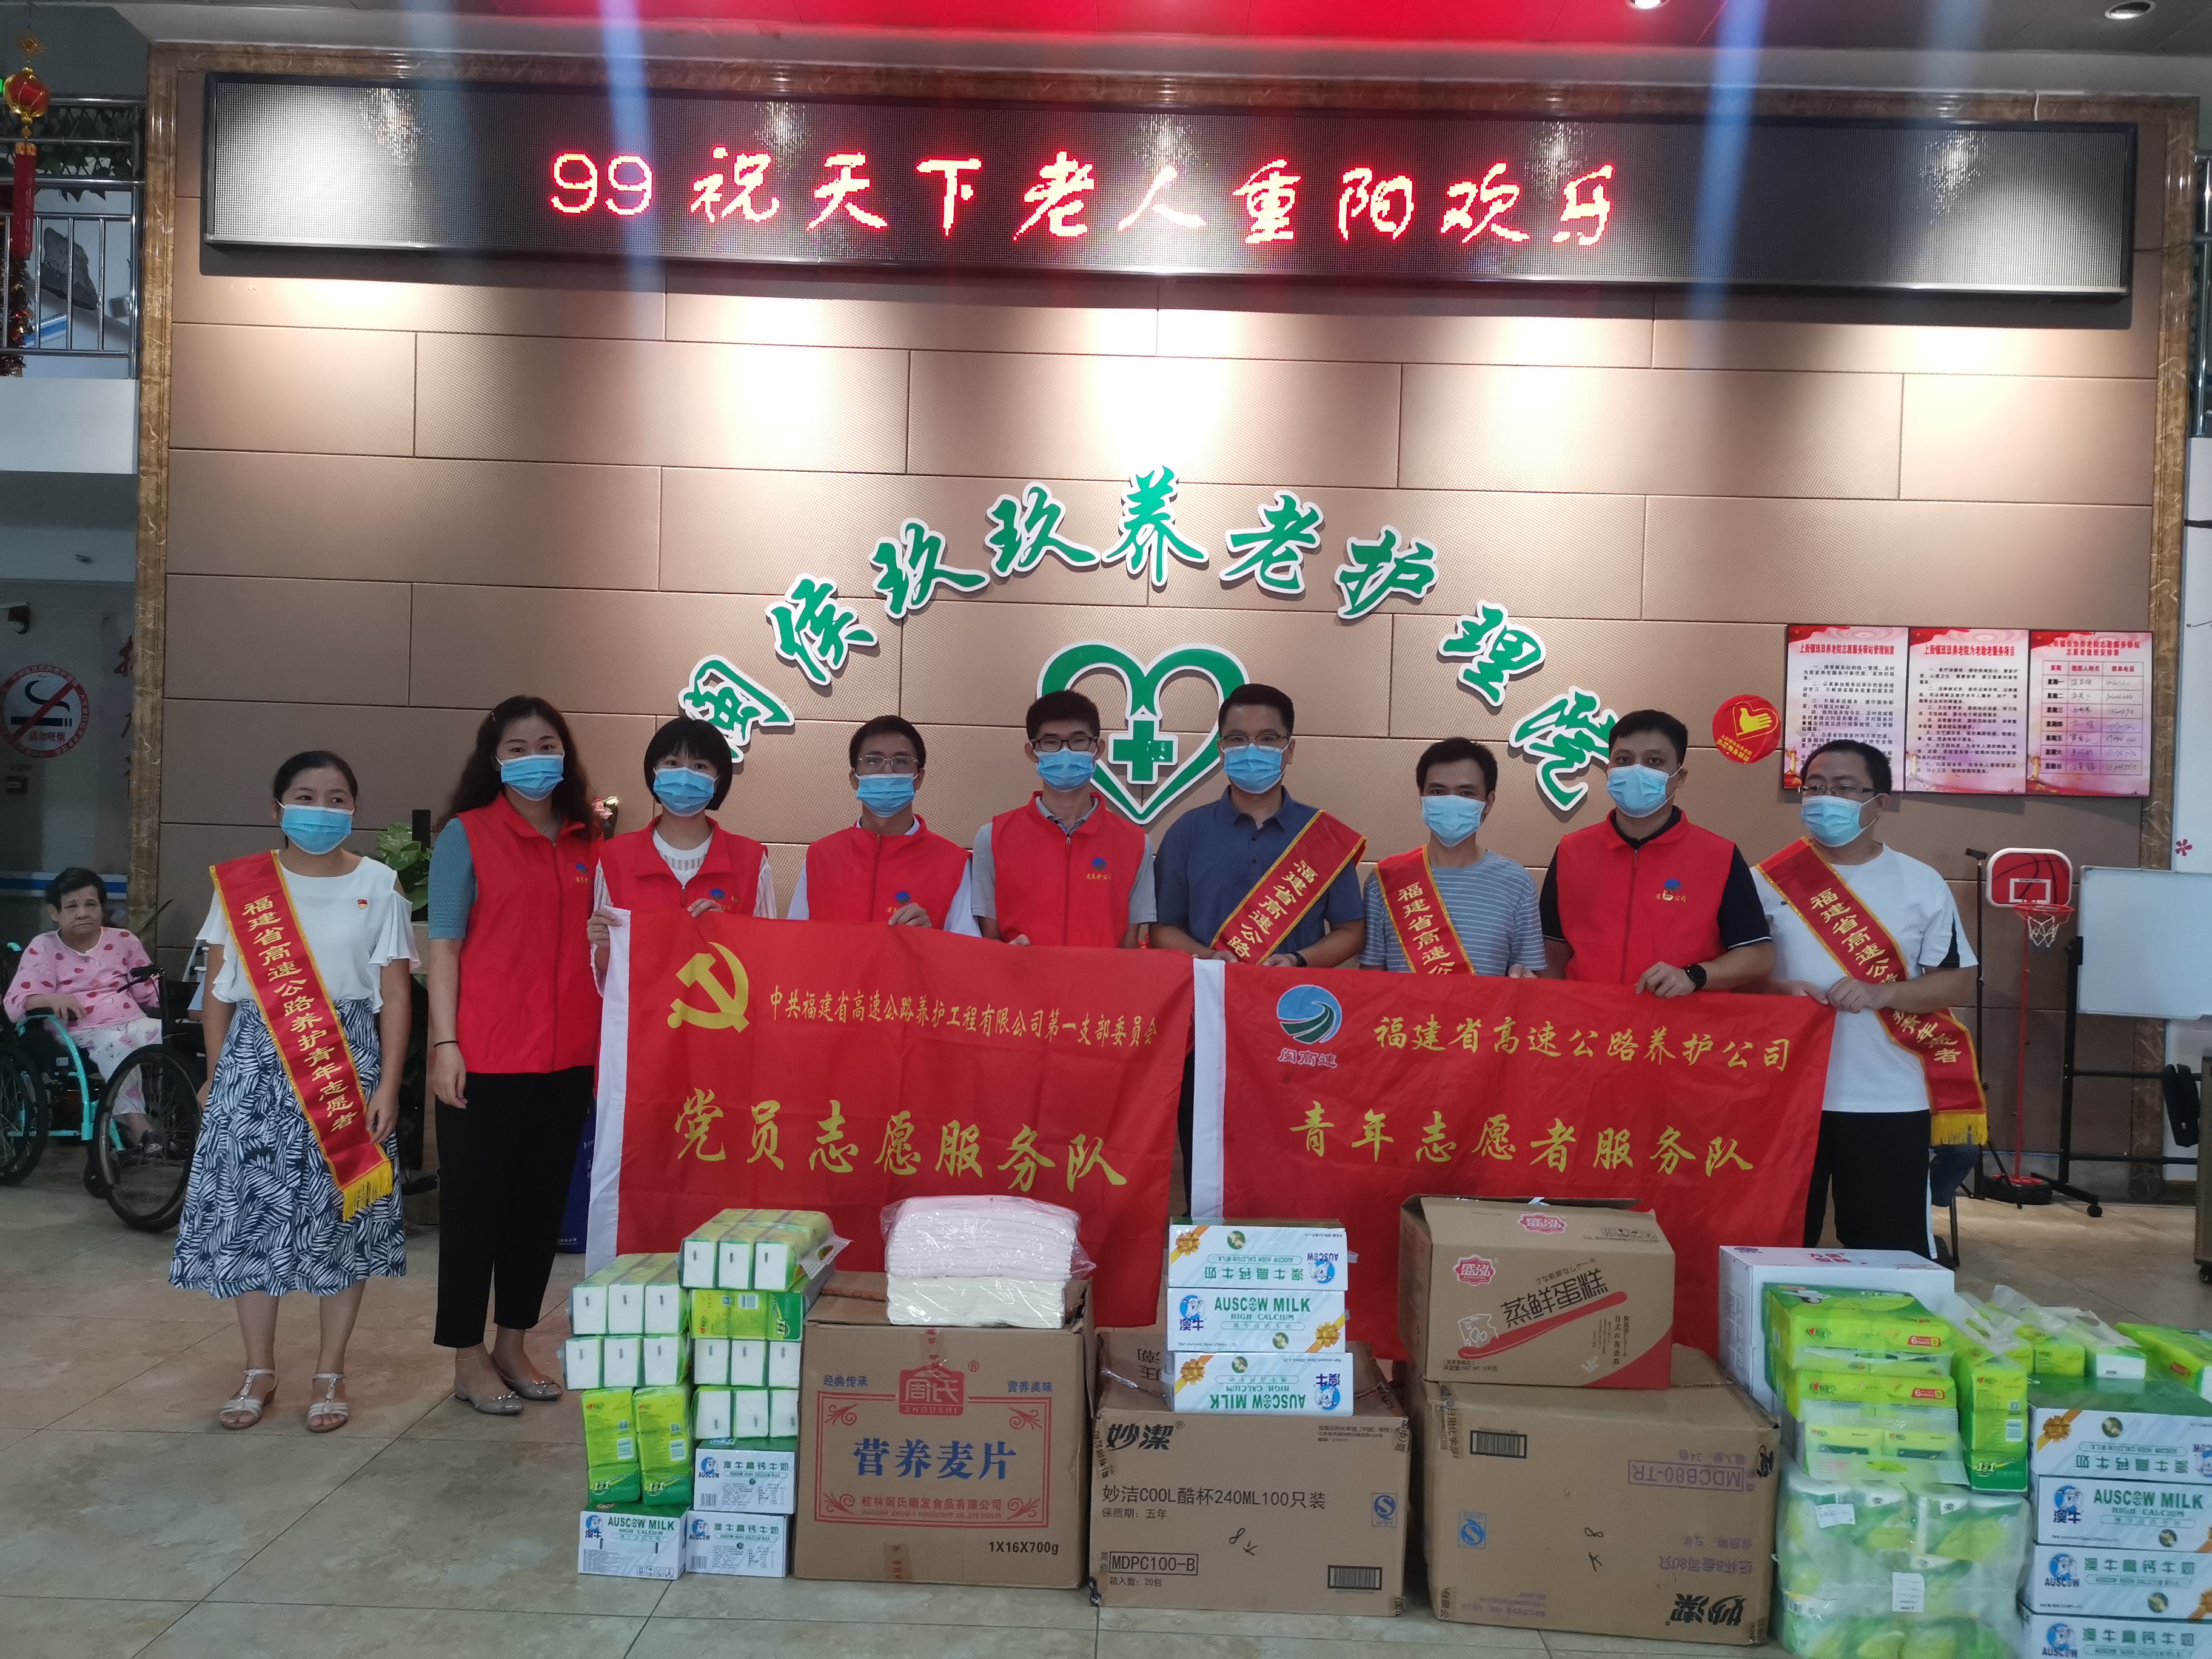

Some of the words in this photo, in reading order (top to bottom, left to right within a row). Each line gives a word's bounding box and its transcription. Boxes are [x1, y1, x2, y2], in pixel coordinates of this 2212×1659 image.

[241, 894, 358, 1133] 福建省高速公路养护青年志愿者
[769, 984, 1158, 1048] 中共福建省高速公路养护工程有限公司第一支部委员会
[1372, 1014, 1792, 1072] 福建省高速公路养护公司
[1278, 1047, 1338, 1068] 闽高速
[674, 1087, 1128, 1194] 党员志愿服务队
[1289, 1100, 1754, 1178] 青年志愿者服务队
[1214, 1296, 1269, 1312] AUSCOW
[1273, 1298, 1311, 1312] MILK
[1179, 1318, 1204, 1332] 澳牛
[823, 1374, 869, 1388] 经典传承
[1007, 1381, 1054, 1393] 营养美味
[1315, 1373, 1341, 1387] 澳牛
[904, 1378, 960, 1404] 周氏
[905, 1405, 958, 1415] ZHOUSHI
[1209, 1394, 1247, 1409] MILK
[1252, 1394, 1306, 1409] AUSCOW
[1105, 1423, 1175, 1451] 妙潔
[853, 1437, 1017, 1481] 营养麦片
[1102, 1484, 1327, 1510] 妙洁COOL酷杯240ML100只装
[2093, 1489, 2156, 1506] AUSCOW
[2160, 1492, 2204, 1510] MILK
[608, 1516, 645, 1529] AUSCOW
[648, 1520, 675, 1530] MILK
[989, 1541, 1059, 1555] 1X16X700g
[1111, 1555, 1196, 1572] MDPC100-B
